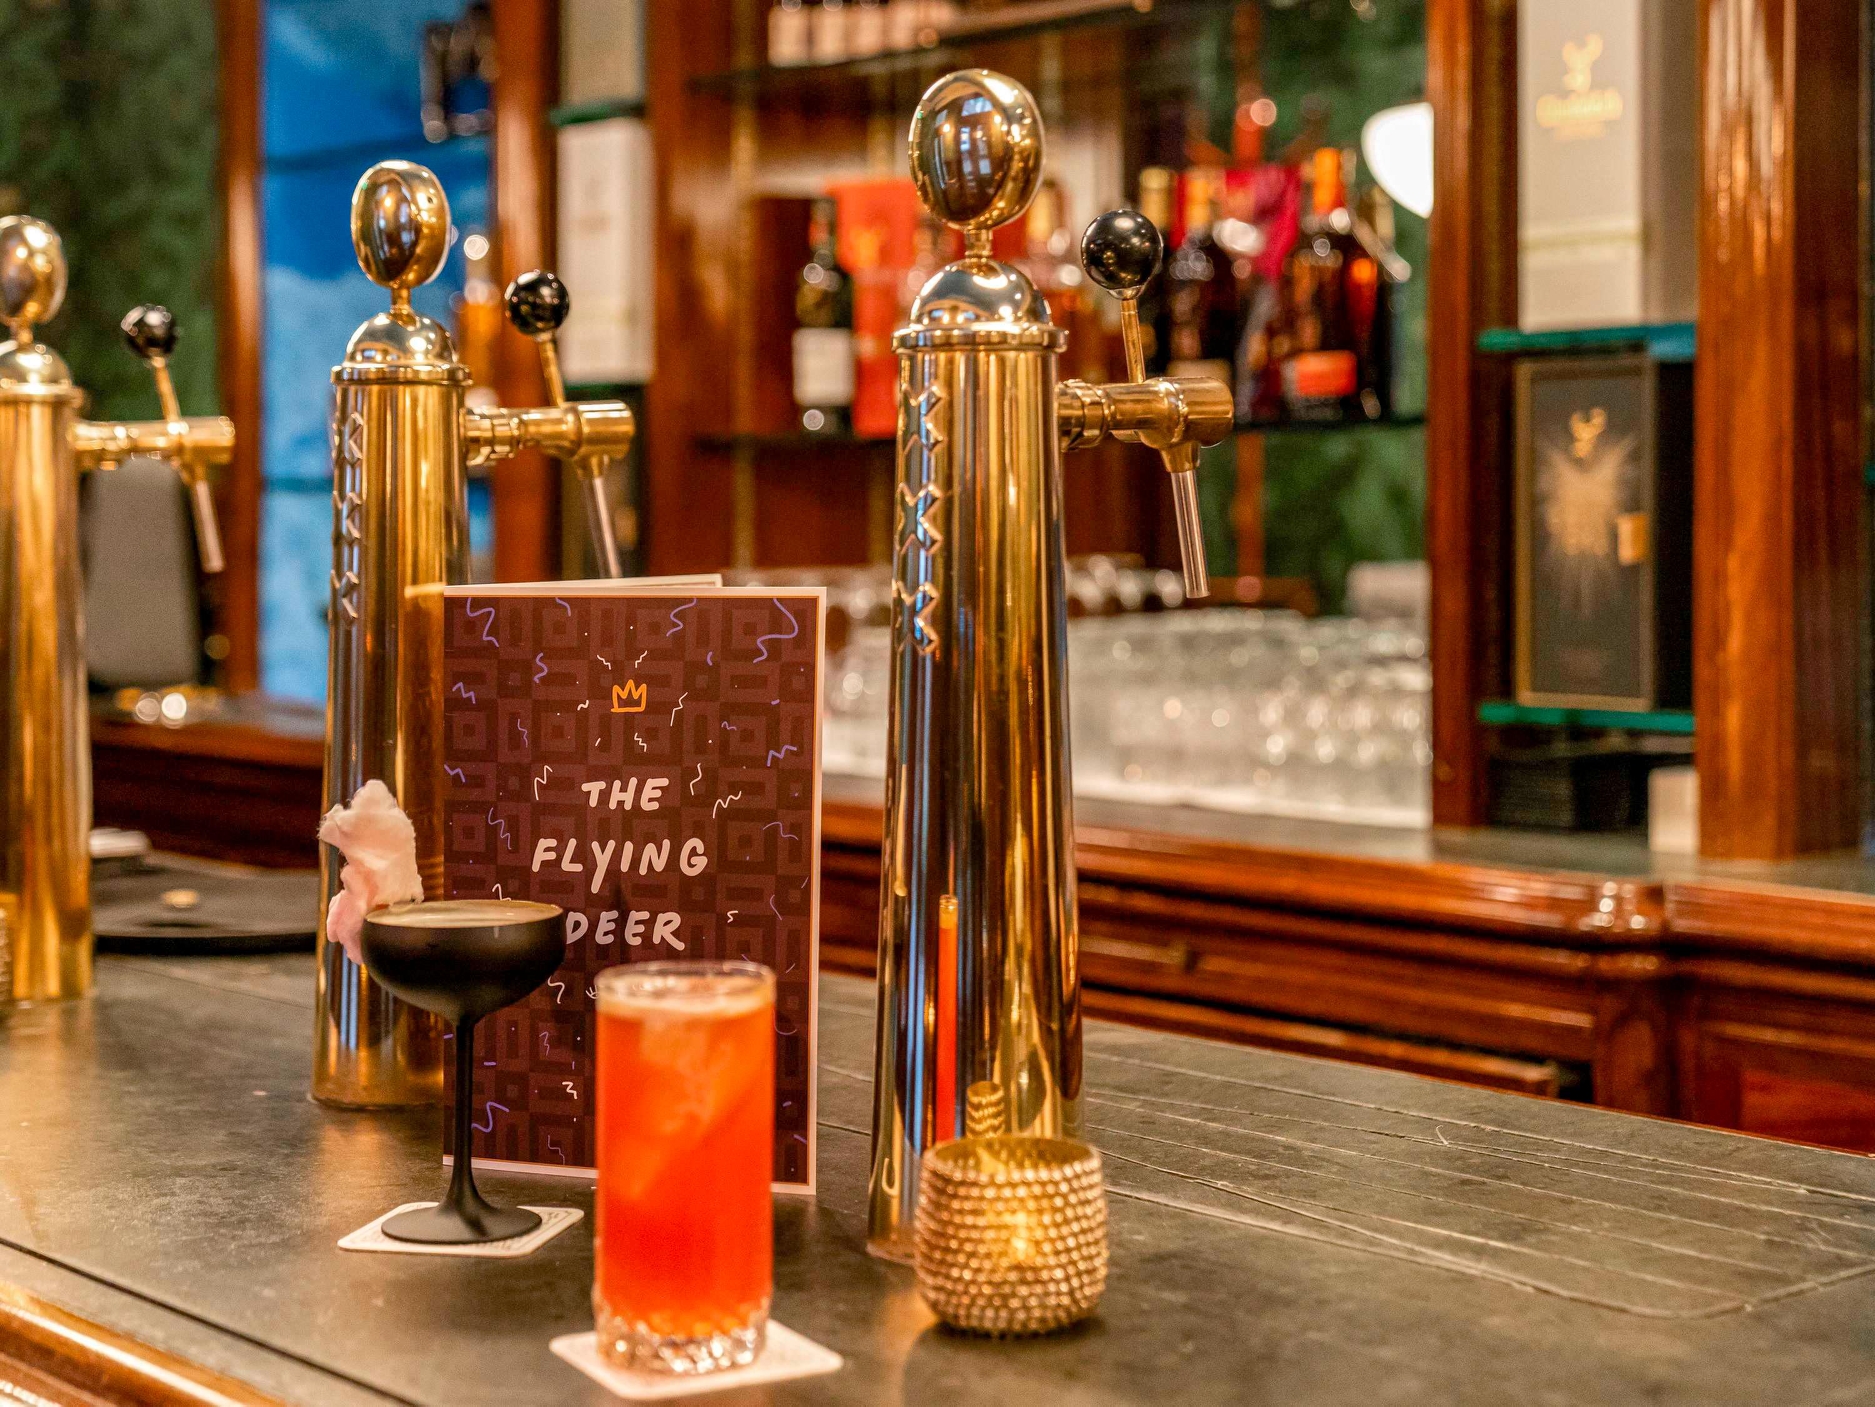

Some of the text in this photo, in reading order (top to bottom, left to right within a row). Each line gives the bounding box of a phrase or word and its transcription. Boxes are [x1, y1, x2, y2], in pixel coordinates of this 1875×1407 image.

[581, 777, 669, 811] THE
[532, 837, 708, 894] FLYING
[565, 910, 685, 951] DEER
